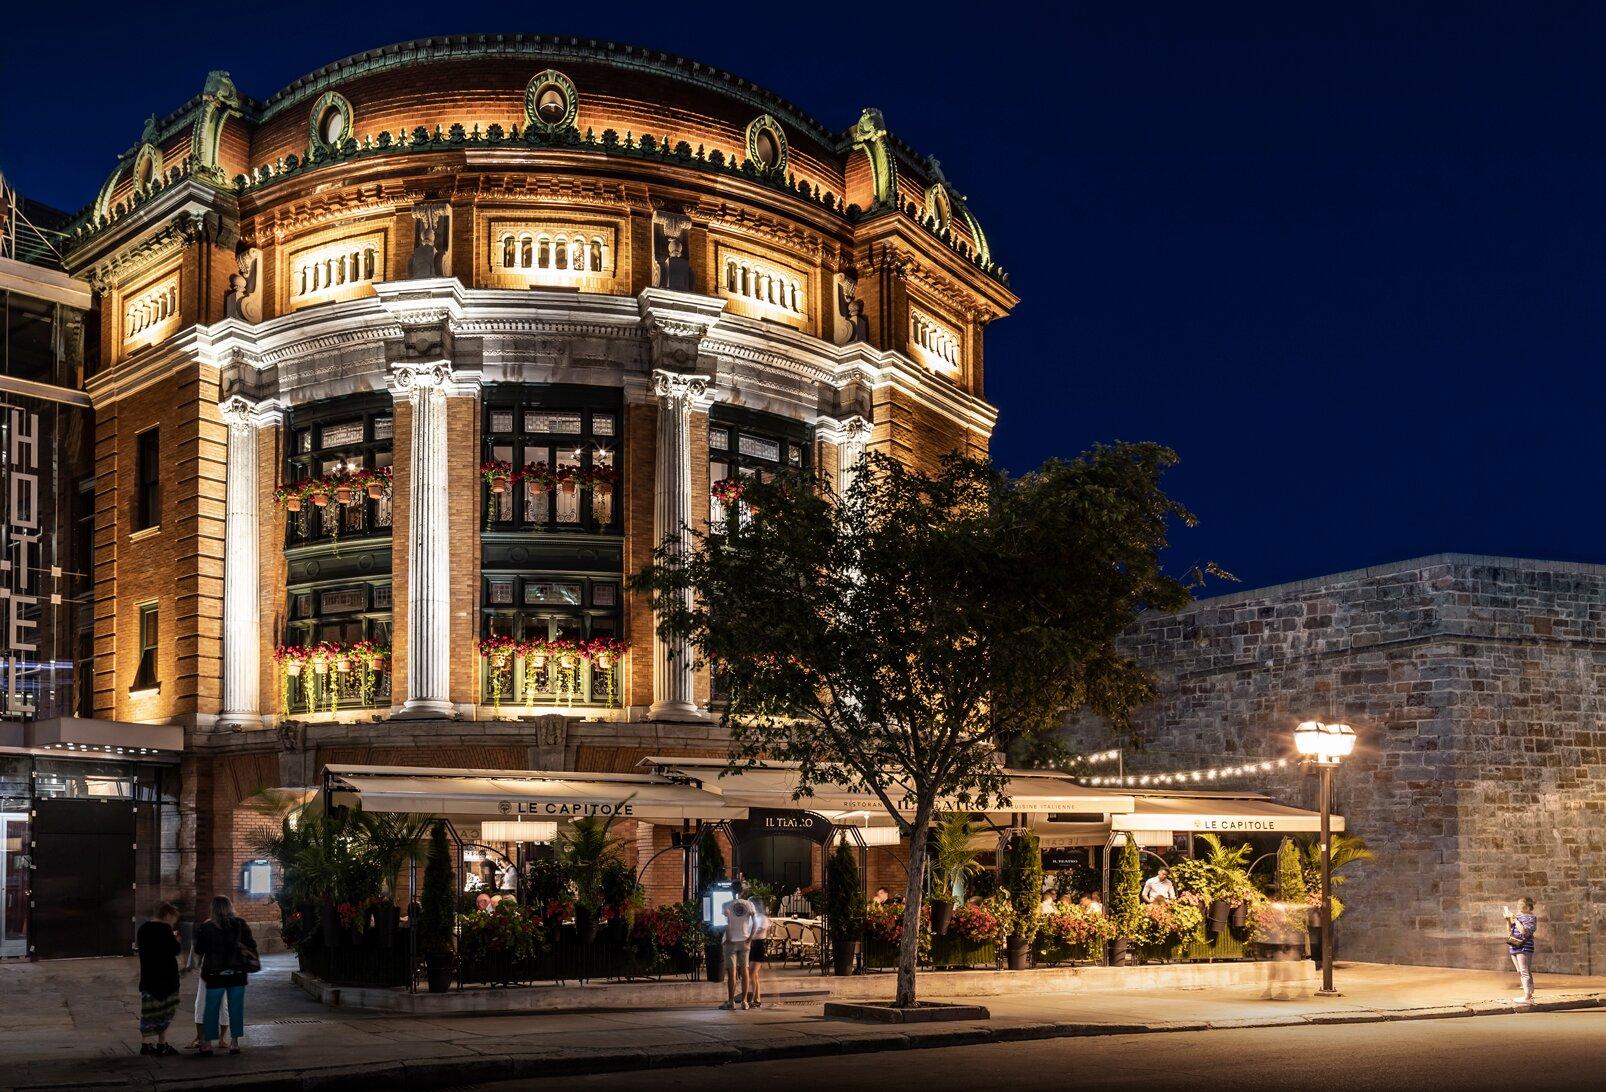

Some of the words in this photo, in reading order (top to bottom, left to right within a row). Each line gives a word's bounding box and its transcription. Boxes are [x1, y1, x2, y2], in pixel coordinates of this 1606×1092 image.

[8, 410, 38, 713] HOTEL
[518, 803, 538, 813] LE
[545, 803, 633, 815] CAPITOLE
[898, 801, 914, 810] IL
[931, 801, 988, 811] EATRO
[765, 817, 775, 827] IL
[1205, 821, 1217, 829] LE
[1221, 821, 1275, 830] CAPITOLE
